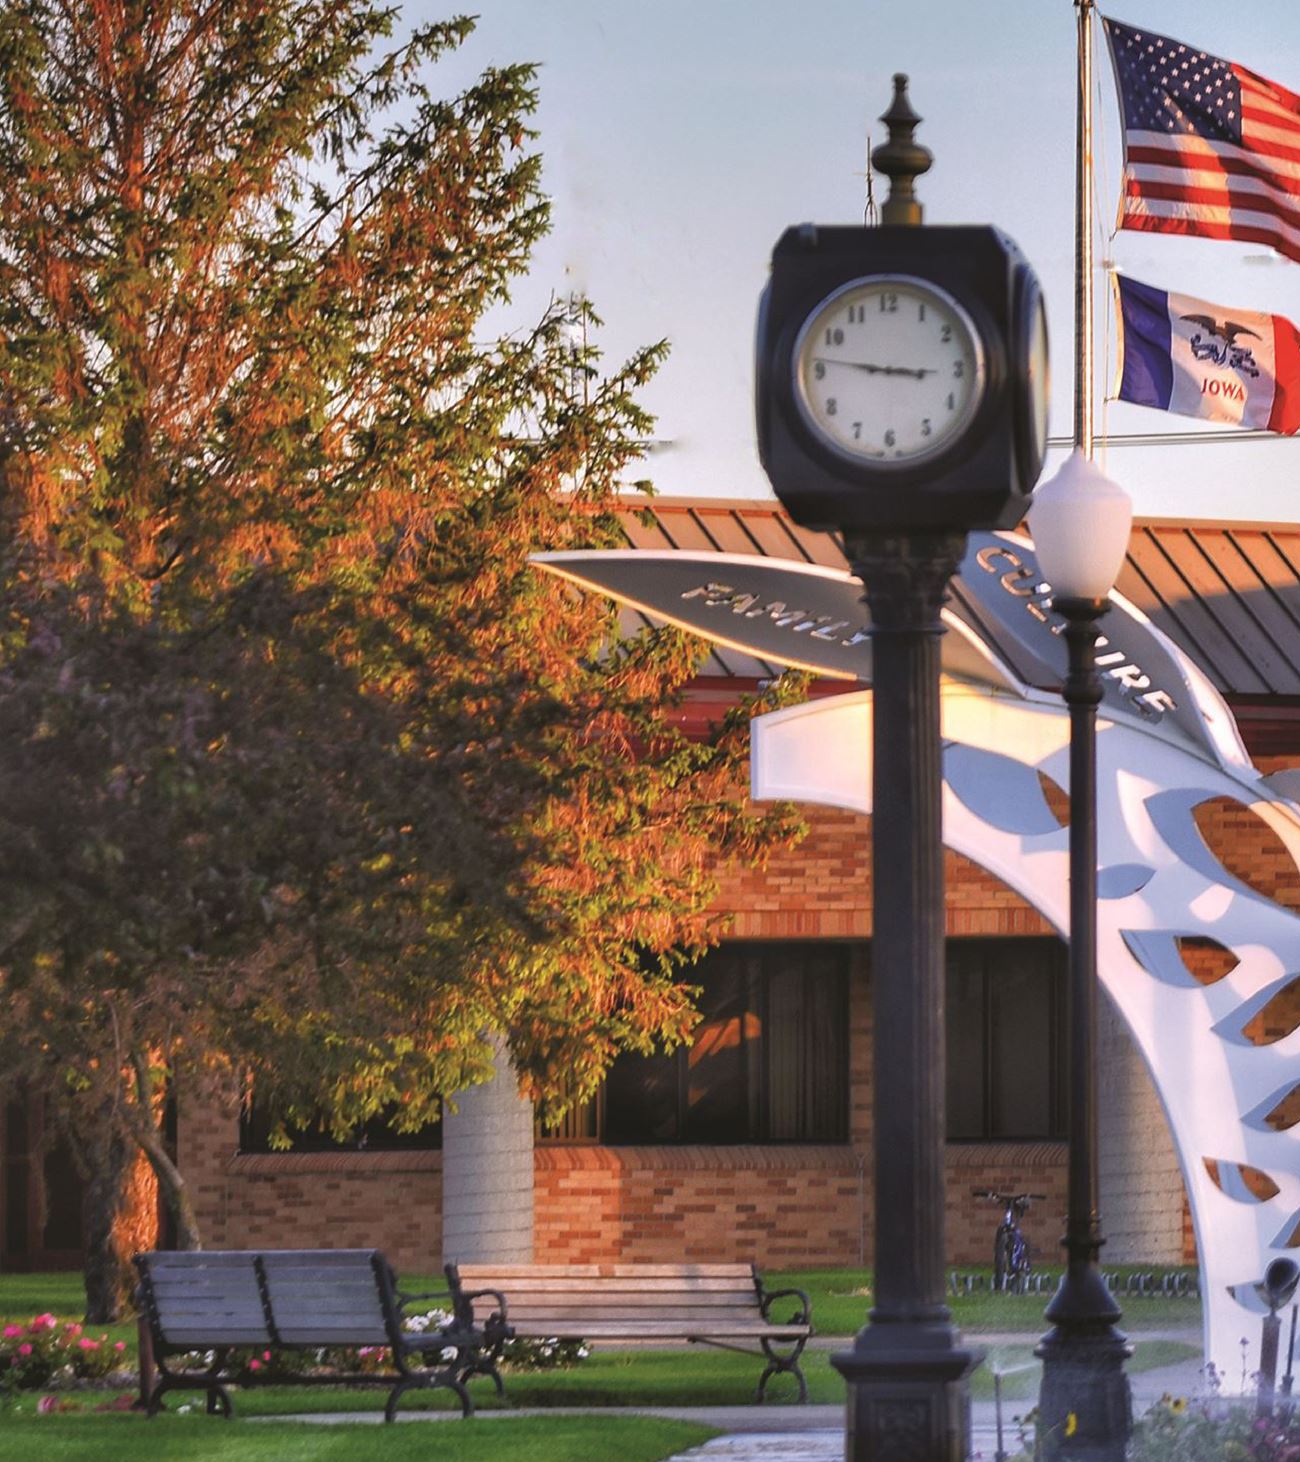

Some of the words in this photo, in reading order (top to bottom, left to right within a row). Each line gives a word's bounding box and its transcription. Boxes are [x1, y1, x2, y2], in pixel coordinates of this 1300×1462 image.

[879, 292, 898, 314] 12
[848, 304, 865, 324] 11
[918, 304, 926, 323] 1
[824, 328, 844, 346] 10
[941, 324, 952, 344] 2
[815, 361, 826, 381] 9
[953, 359, 964, 379] 3
[1200, 377, 1247, 402] IOWA
[826, 397, 838, 416] 8
[851, 421, 863, 440] 7
[920, 418, 932, 437] 5
[884, 429, 896, 448] 6
[976, 547, 1178, 724] CULURE
